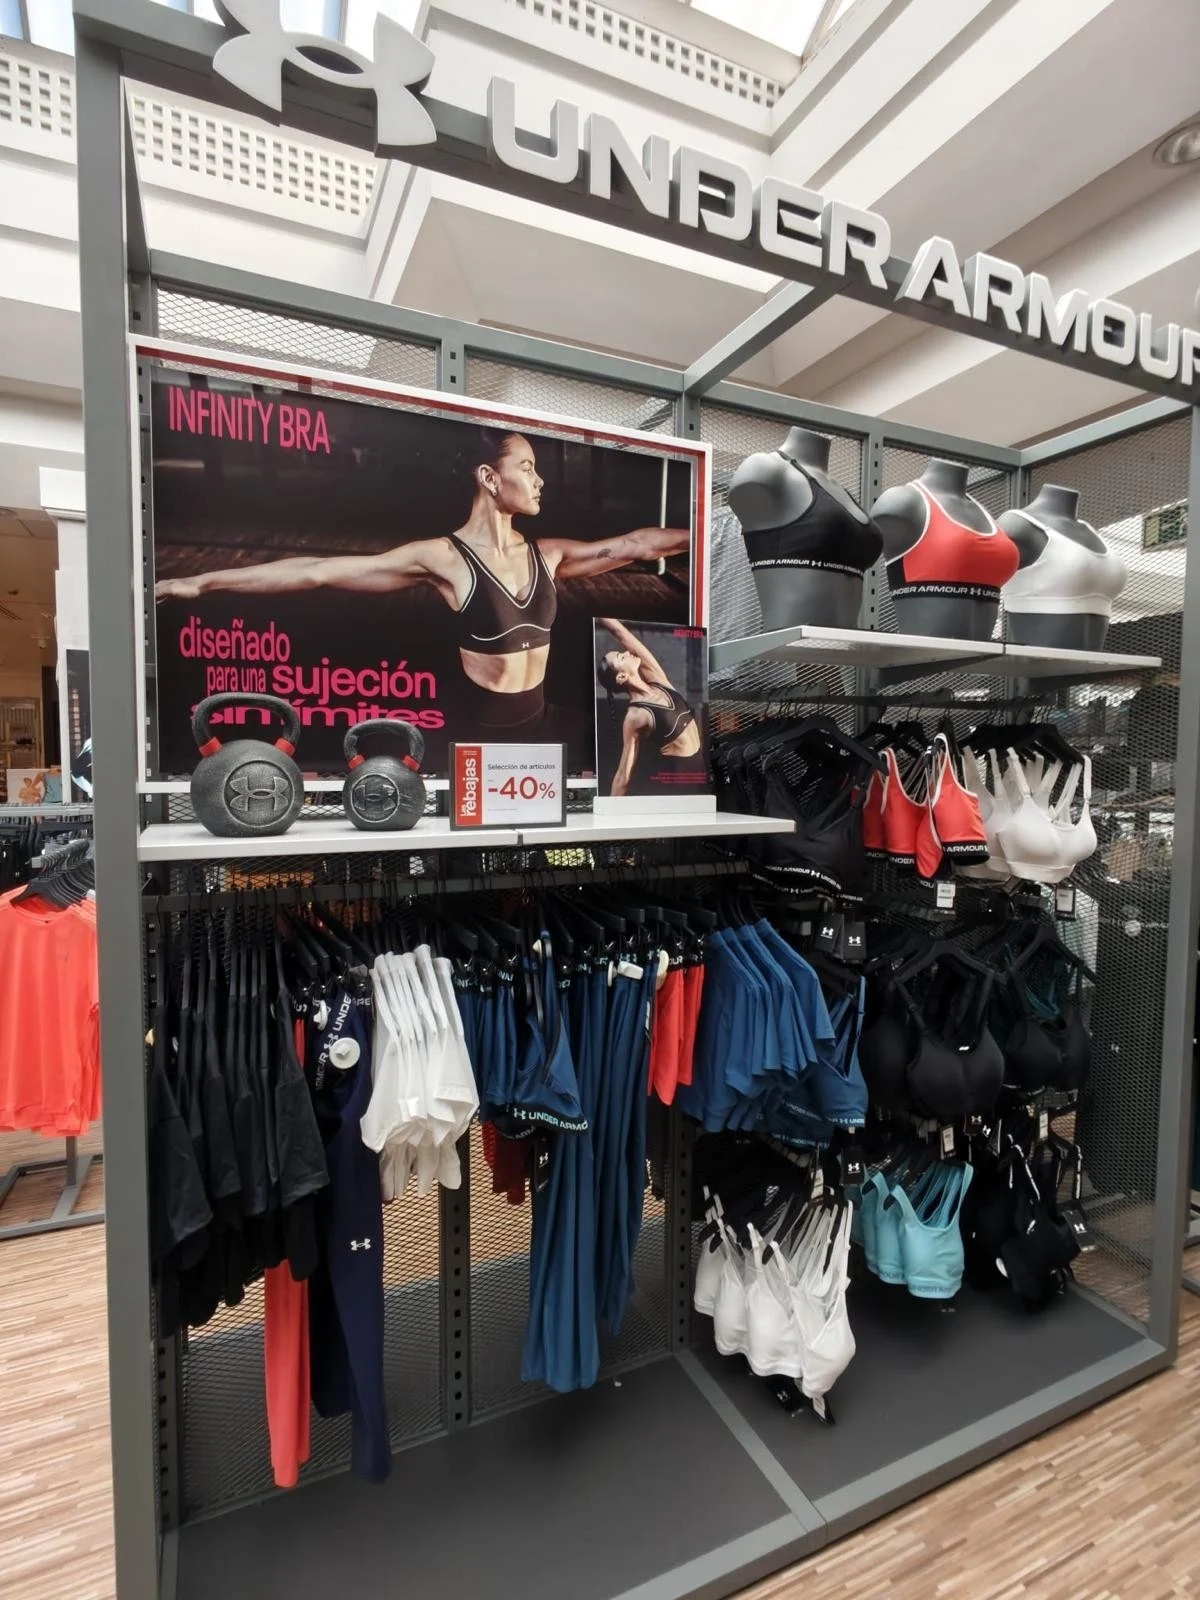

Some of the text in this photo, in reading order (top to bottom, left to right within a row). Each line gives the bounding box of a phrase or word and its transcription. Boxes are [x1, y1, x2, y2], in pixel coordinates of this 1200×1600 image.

[487, 76, 891, 290] UNDER
[168, 385, 331, 454] INFINITY BRA
[917, 585, 968, 594] ARMOUR
[179, 615, 291, 662] diseñado
[207, 657, 437, 705] para una sujeción
[190, 697, 445, 729] in ímites
[463, 758, 479, 816] rebajas
[488, 776, 556, 799] -40%
[946, 844, 984, 852] ARMOUR
[528, 1111, 559, 1127] UNDER
